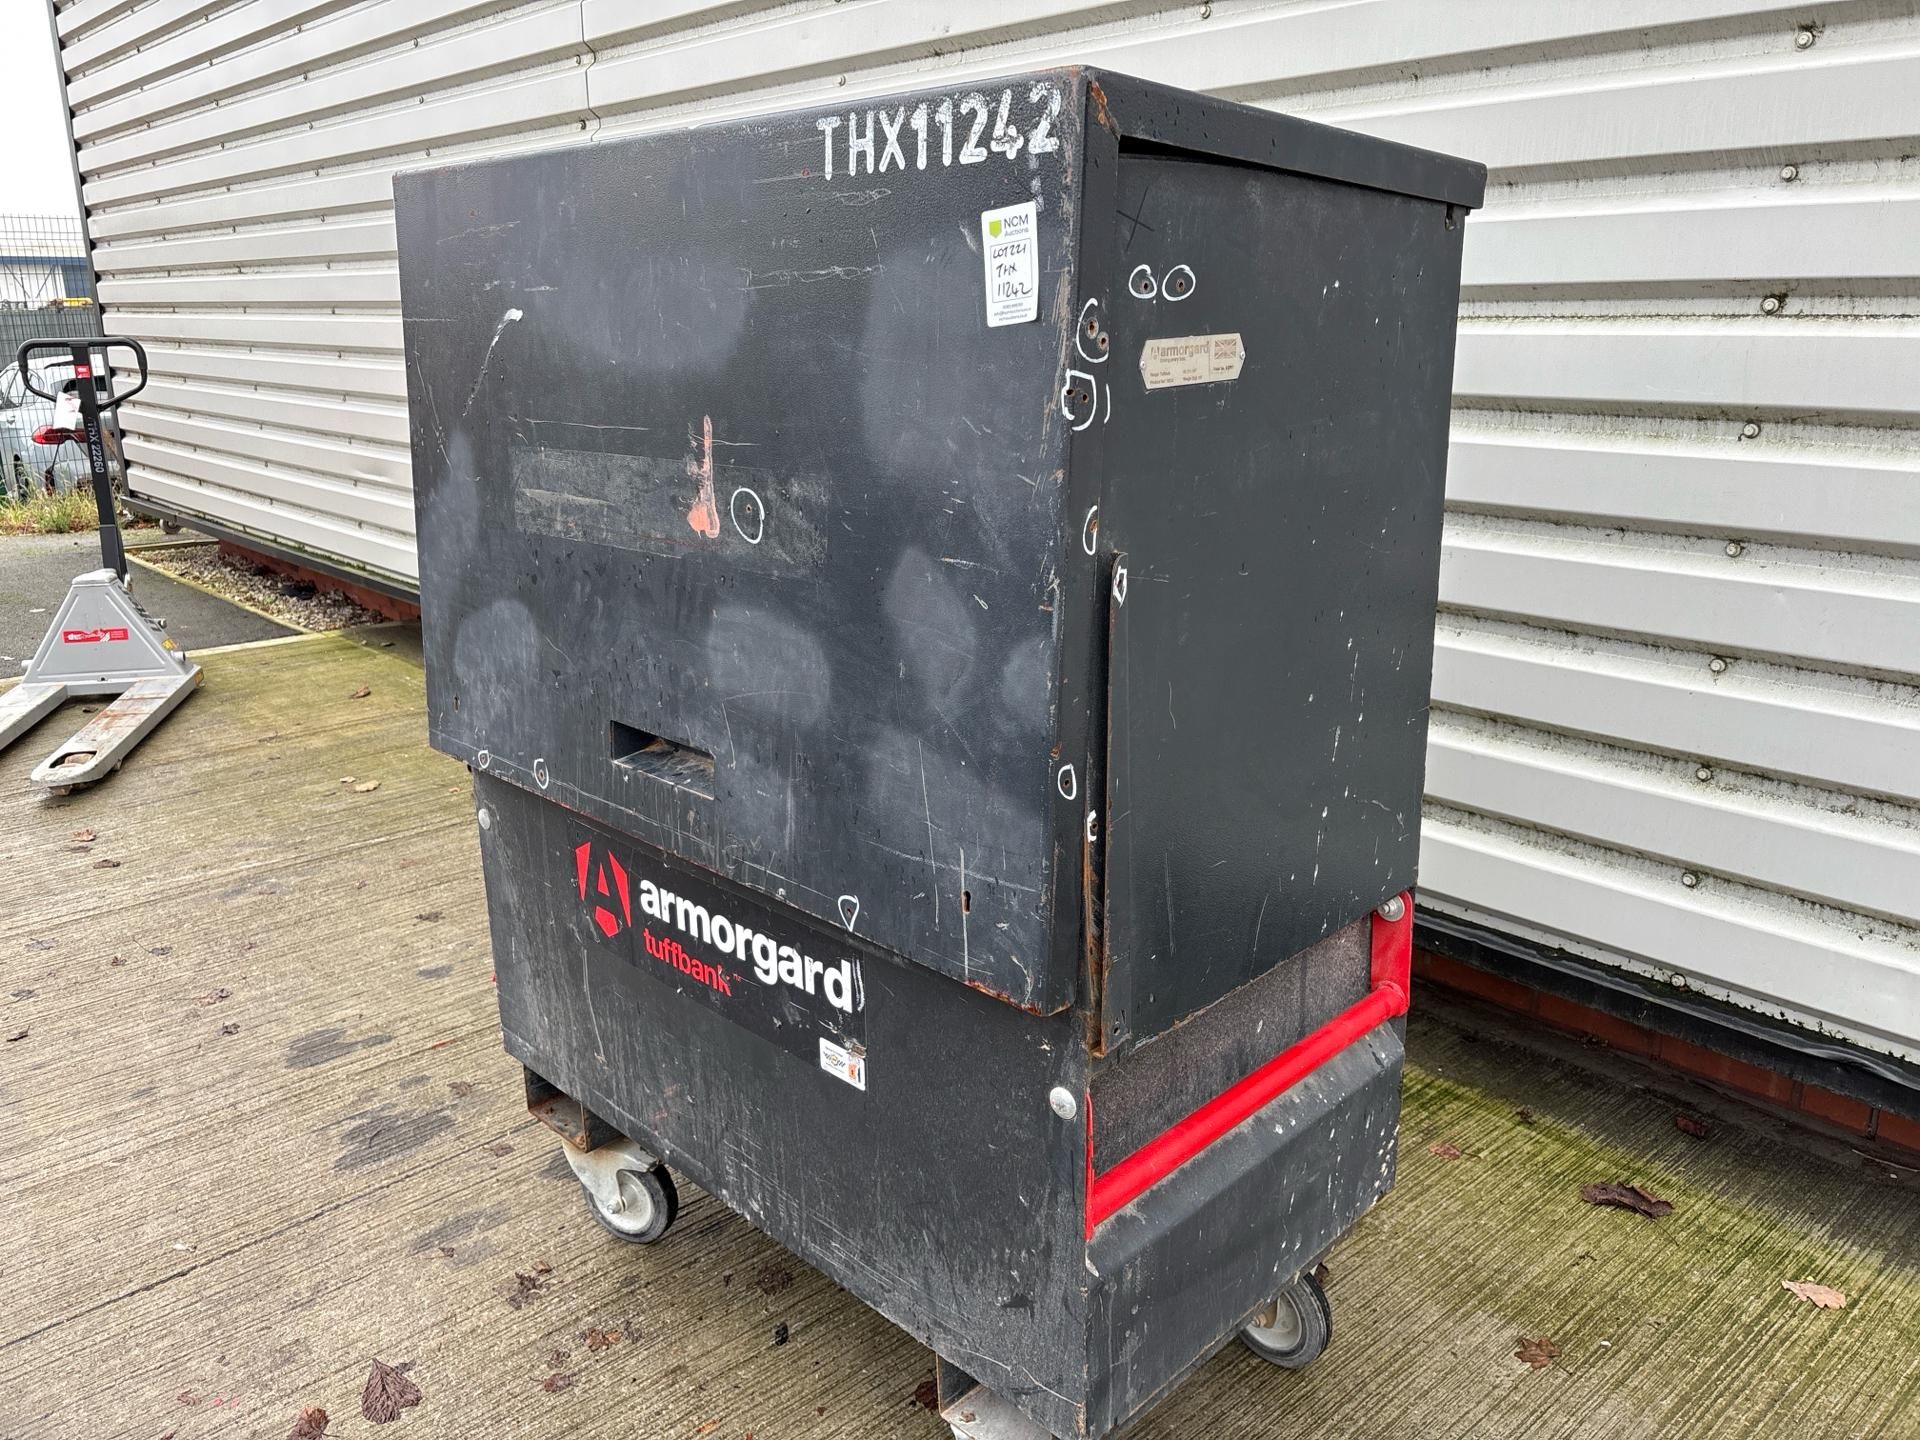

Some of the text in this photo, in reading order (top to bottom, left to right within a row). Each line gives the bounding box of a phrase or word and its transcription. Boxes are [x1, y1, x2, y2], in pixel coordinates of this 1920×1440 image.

[816, 81, 1061, 181] THX11242
[1003, 214, 1029, 230] NCM
[1004, 227, 1029, 238] Auctions
[996, 262, 1017, 278] THX
[997, 281, 1033, 298] 11242
[91, 443, 105, 473] 22260
[639, 879, 853, 1014] armorgard
[643, 927, 733, 997] tuffbank
